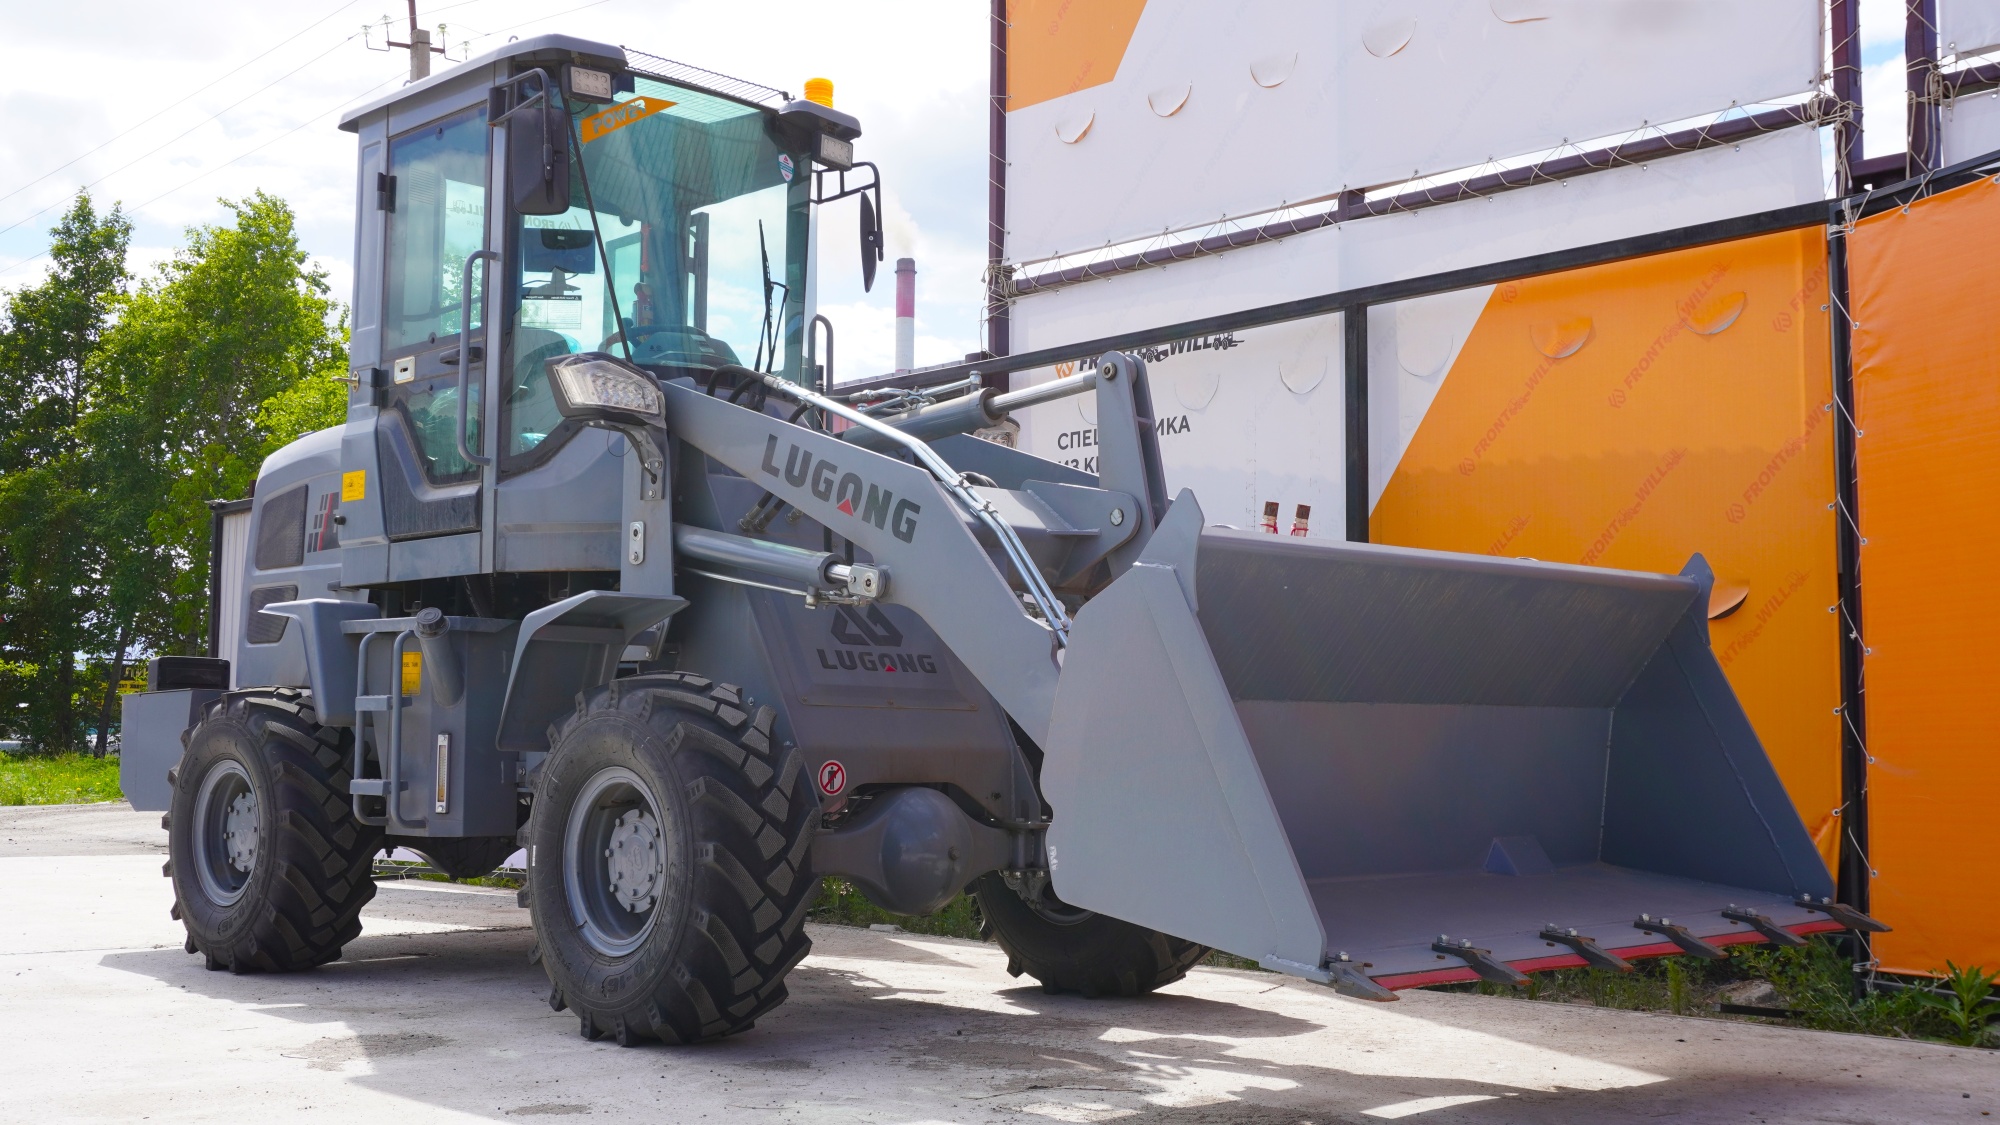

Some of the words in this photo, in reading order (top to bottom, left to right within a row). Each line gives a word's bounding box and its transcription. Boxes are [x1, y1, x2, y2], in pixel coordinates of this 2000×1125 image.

[592, 99, 646, 134] POWER
[1624, 336, 1665, 390] FRONT
[1681, 280, 1714, 317] WILL
[1473, 408, 1510, 459] FRONT
[761, 433, 921, 544] LUGONG
[1635, 466, 1669, 502] WILL
[1743, 449, 1787, 505] FRONT
[1756, 586, 1791, 624] WILL
[816, 648, 938, 674] LUGONG
